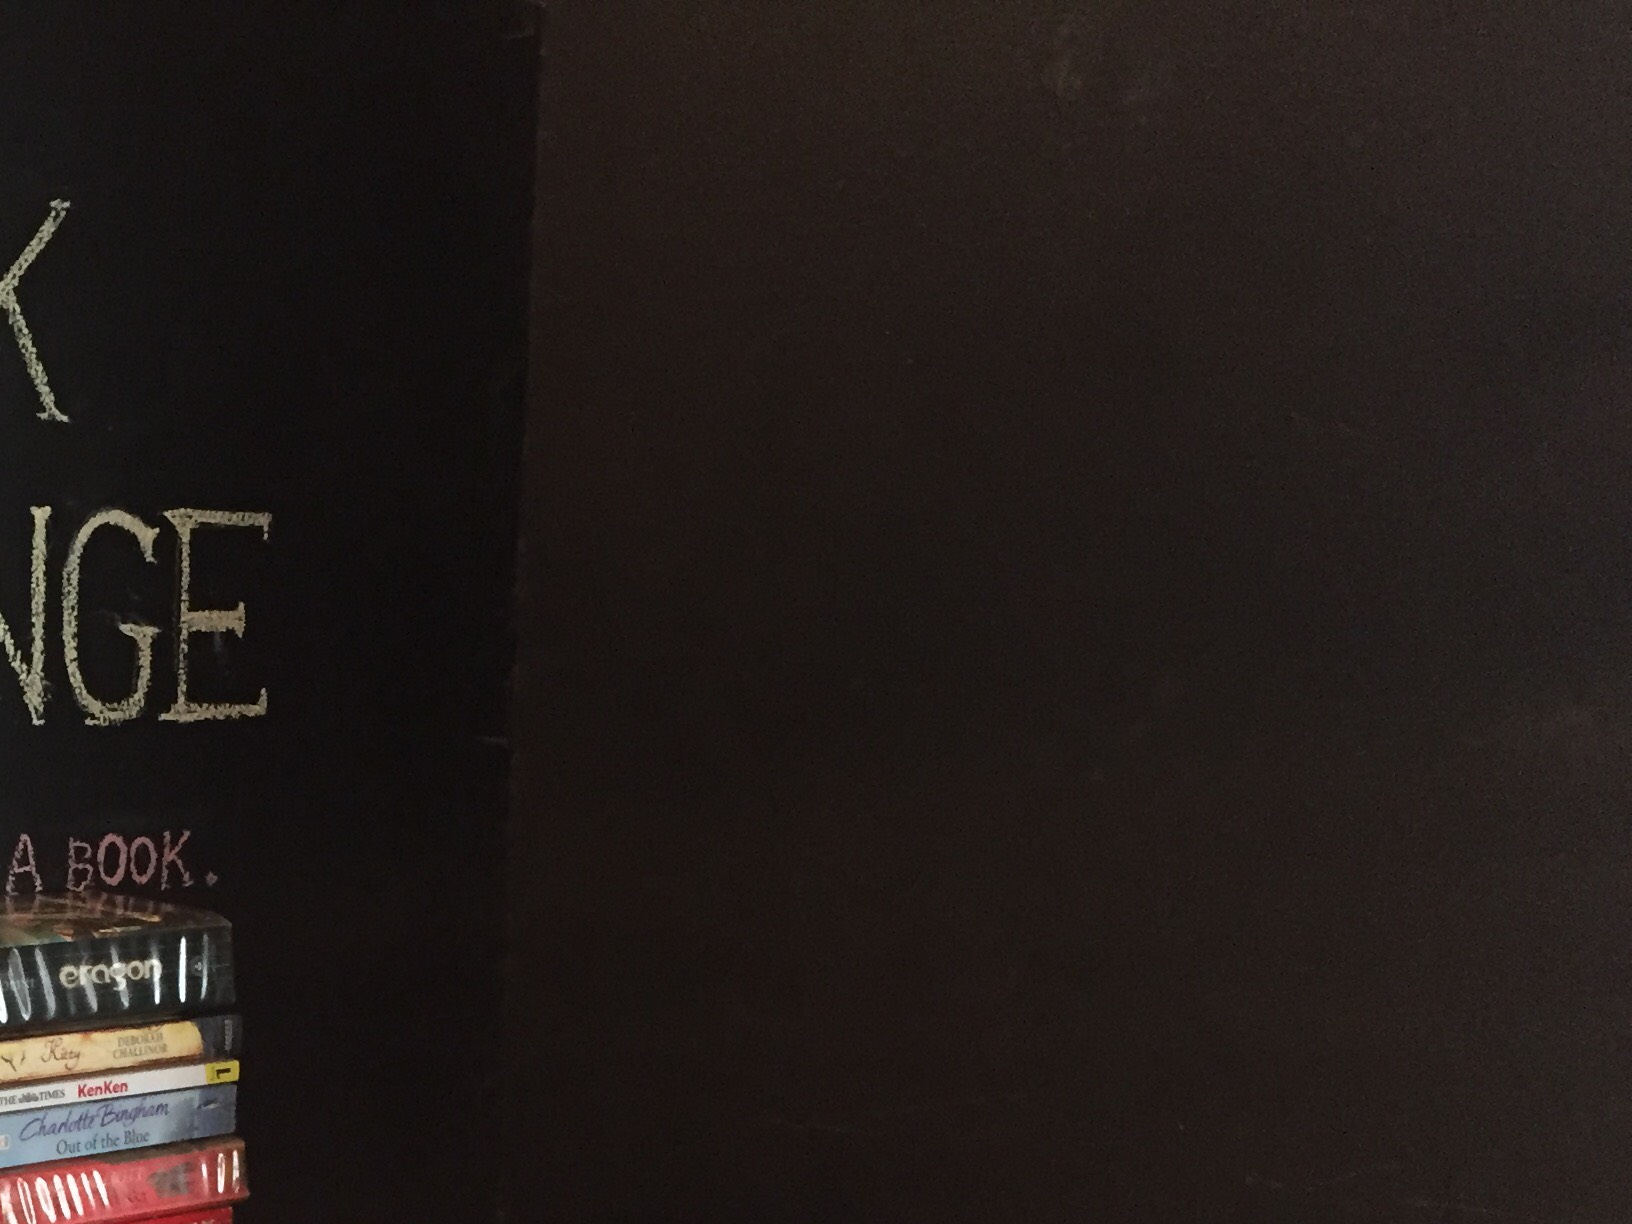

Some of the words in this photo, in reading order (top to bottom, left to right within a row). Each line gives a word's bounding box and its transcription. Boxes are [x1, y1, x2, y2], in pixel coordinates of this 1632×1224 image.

[6, 833, 43, 896] A
[68, 829, 218, 893] BOOK.
[59, 958, 163, 991] eragon
[39, 1088, 66, 1105] TIMES
[77, 1080, 129, 1099] KenKen
[19, 1110, 96, 1142] Charlotte
[100, 1099, 169, 1128] Bingham
[55, 1136, 82, 1156] Out
[83, 1135, 100, 1151] of
[100, 1132, 121, 1149] the
[123, 1128, 150, 1146] Blue
